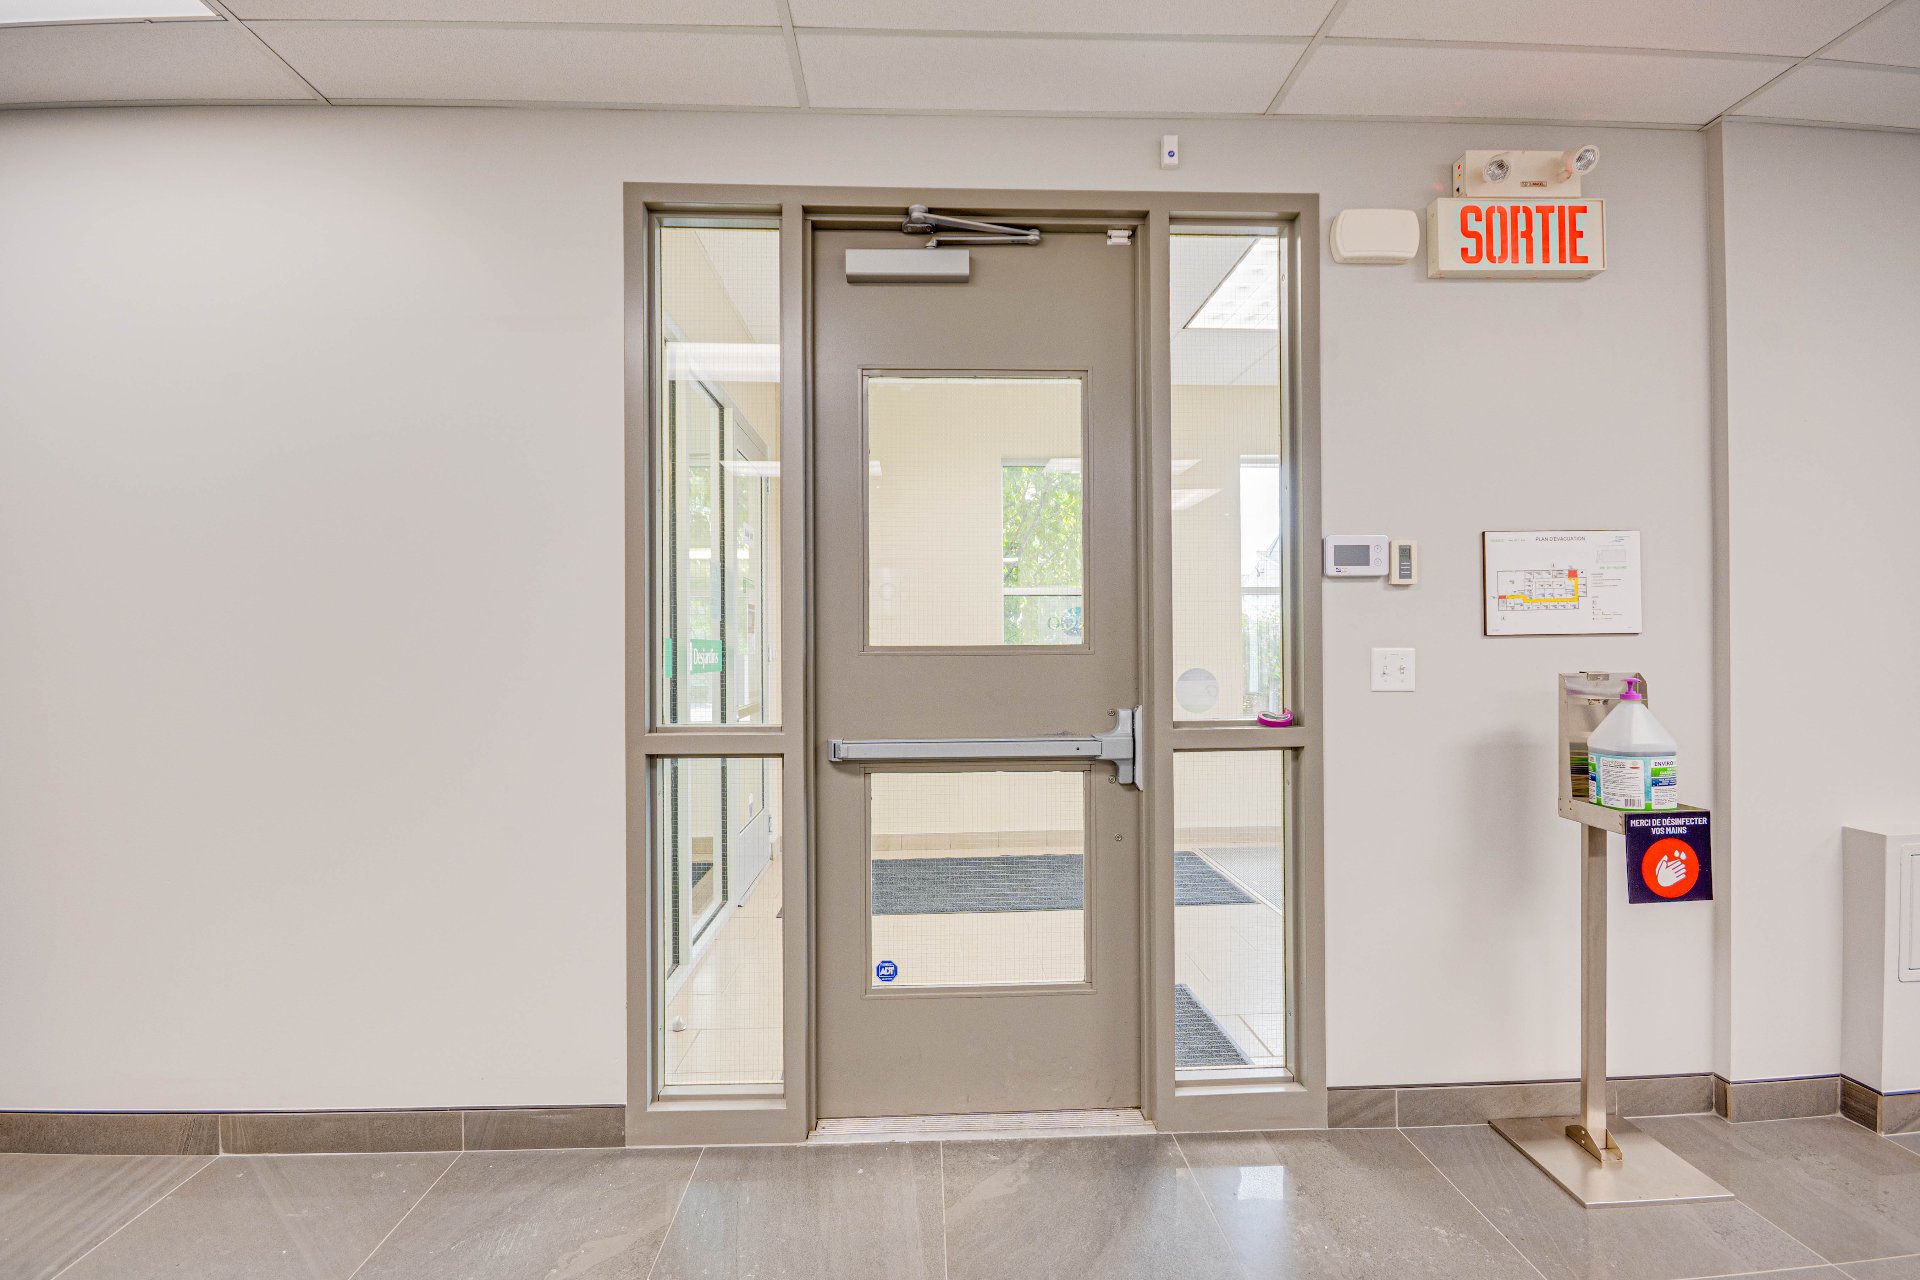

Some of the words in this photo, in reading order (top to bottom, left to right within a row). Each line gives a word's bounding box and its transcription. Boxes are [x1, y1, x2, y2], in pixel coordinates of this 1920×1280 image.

[1460, 205, 1588, 264] SORTIE
[693, 648, 719, 669] Desjardins
[1630, 819, 1651, 827] MERCI
[1651, 818, 1662, 826] DE
[1662, 817, 1707, 826] DÉSINFECTER
[1651, 827, 1665, 835] VOS
[880, 966, 894, 975] ADT
